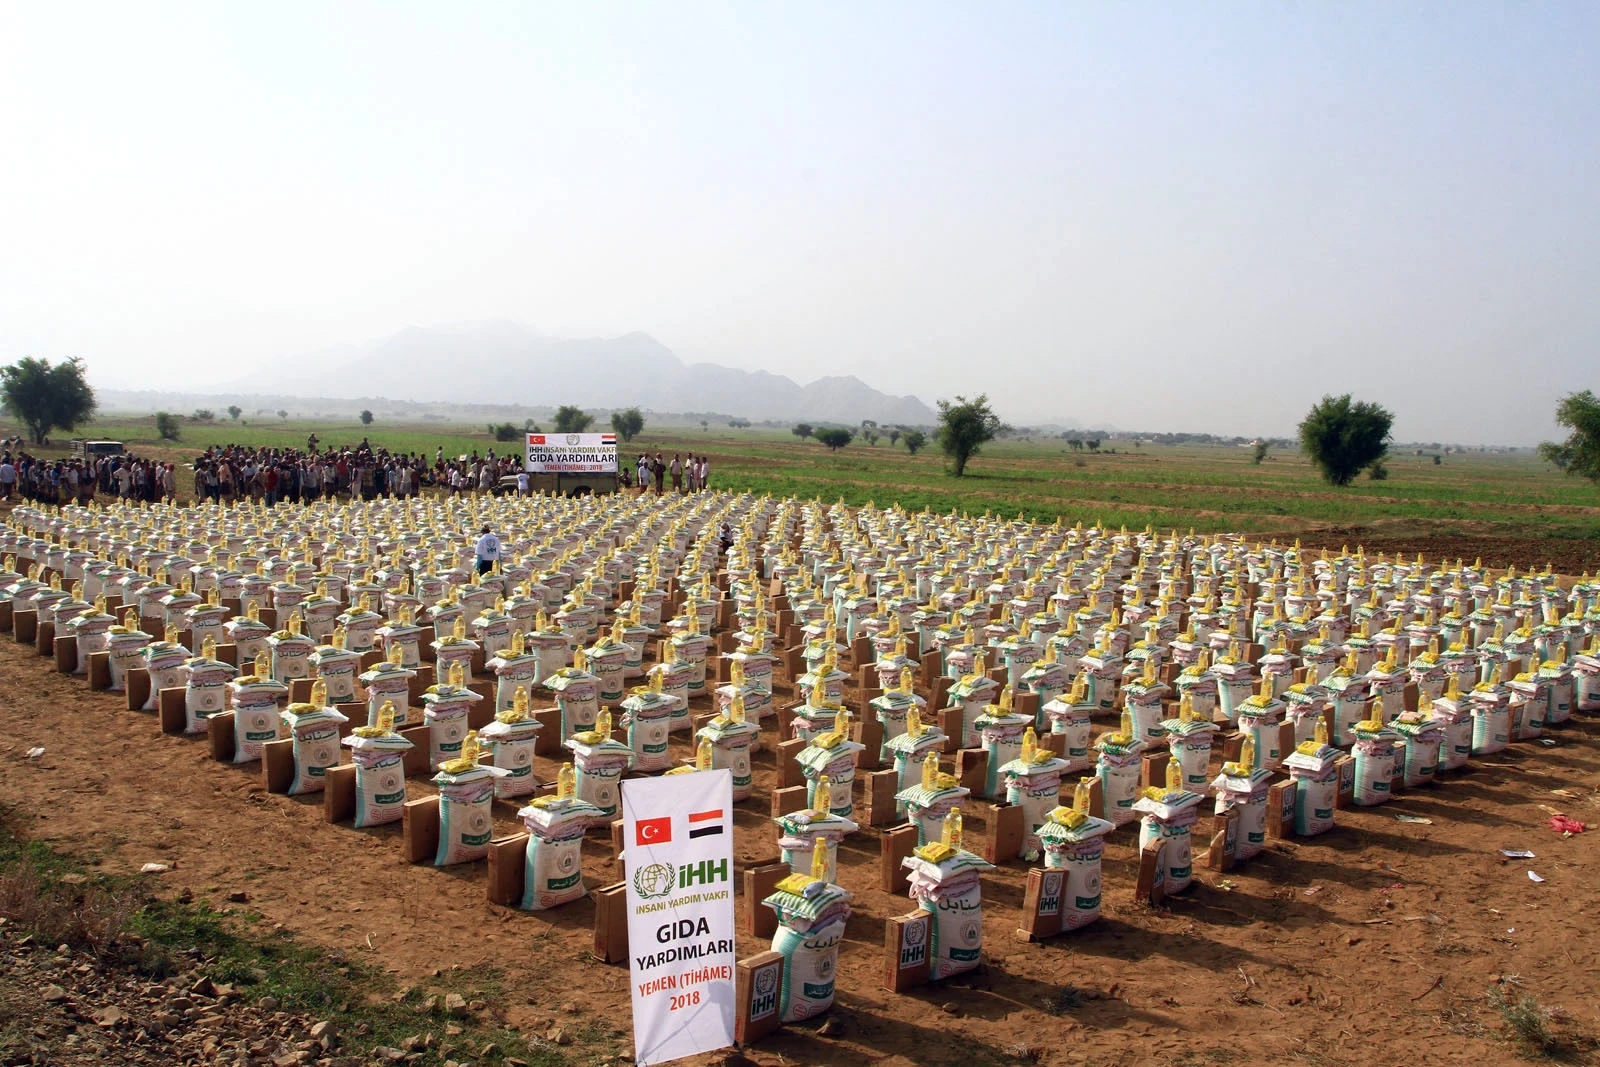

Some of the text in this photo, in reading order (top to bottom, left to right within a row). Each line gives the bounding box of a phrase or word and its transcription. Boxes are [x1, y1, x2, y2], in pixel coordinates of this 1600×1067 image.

[529, 453, 618, 463] GIDA YARDIMLARI
[668, 893, 701, 909] YARDIM
[702, 890, 729, 901] VAKFI
[656, 916, 710, 944] GIDA
[636, 939, 734, 971] YARDIMLARI
[638, 975, 677, 998] YEMEN
[669, 990, 700, 1011] 2018
